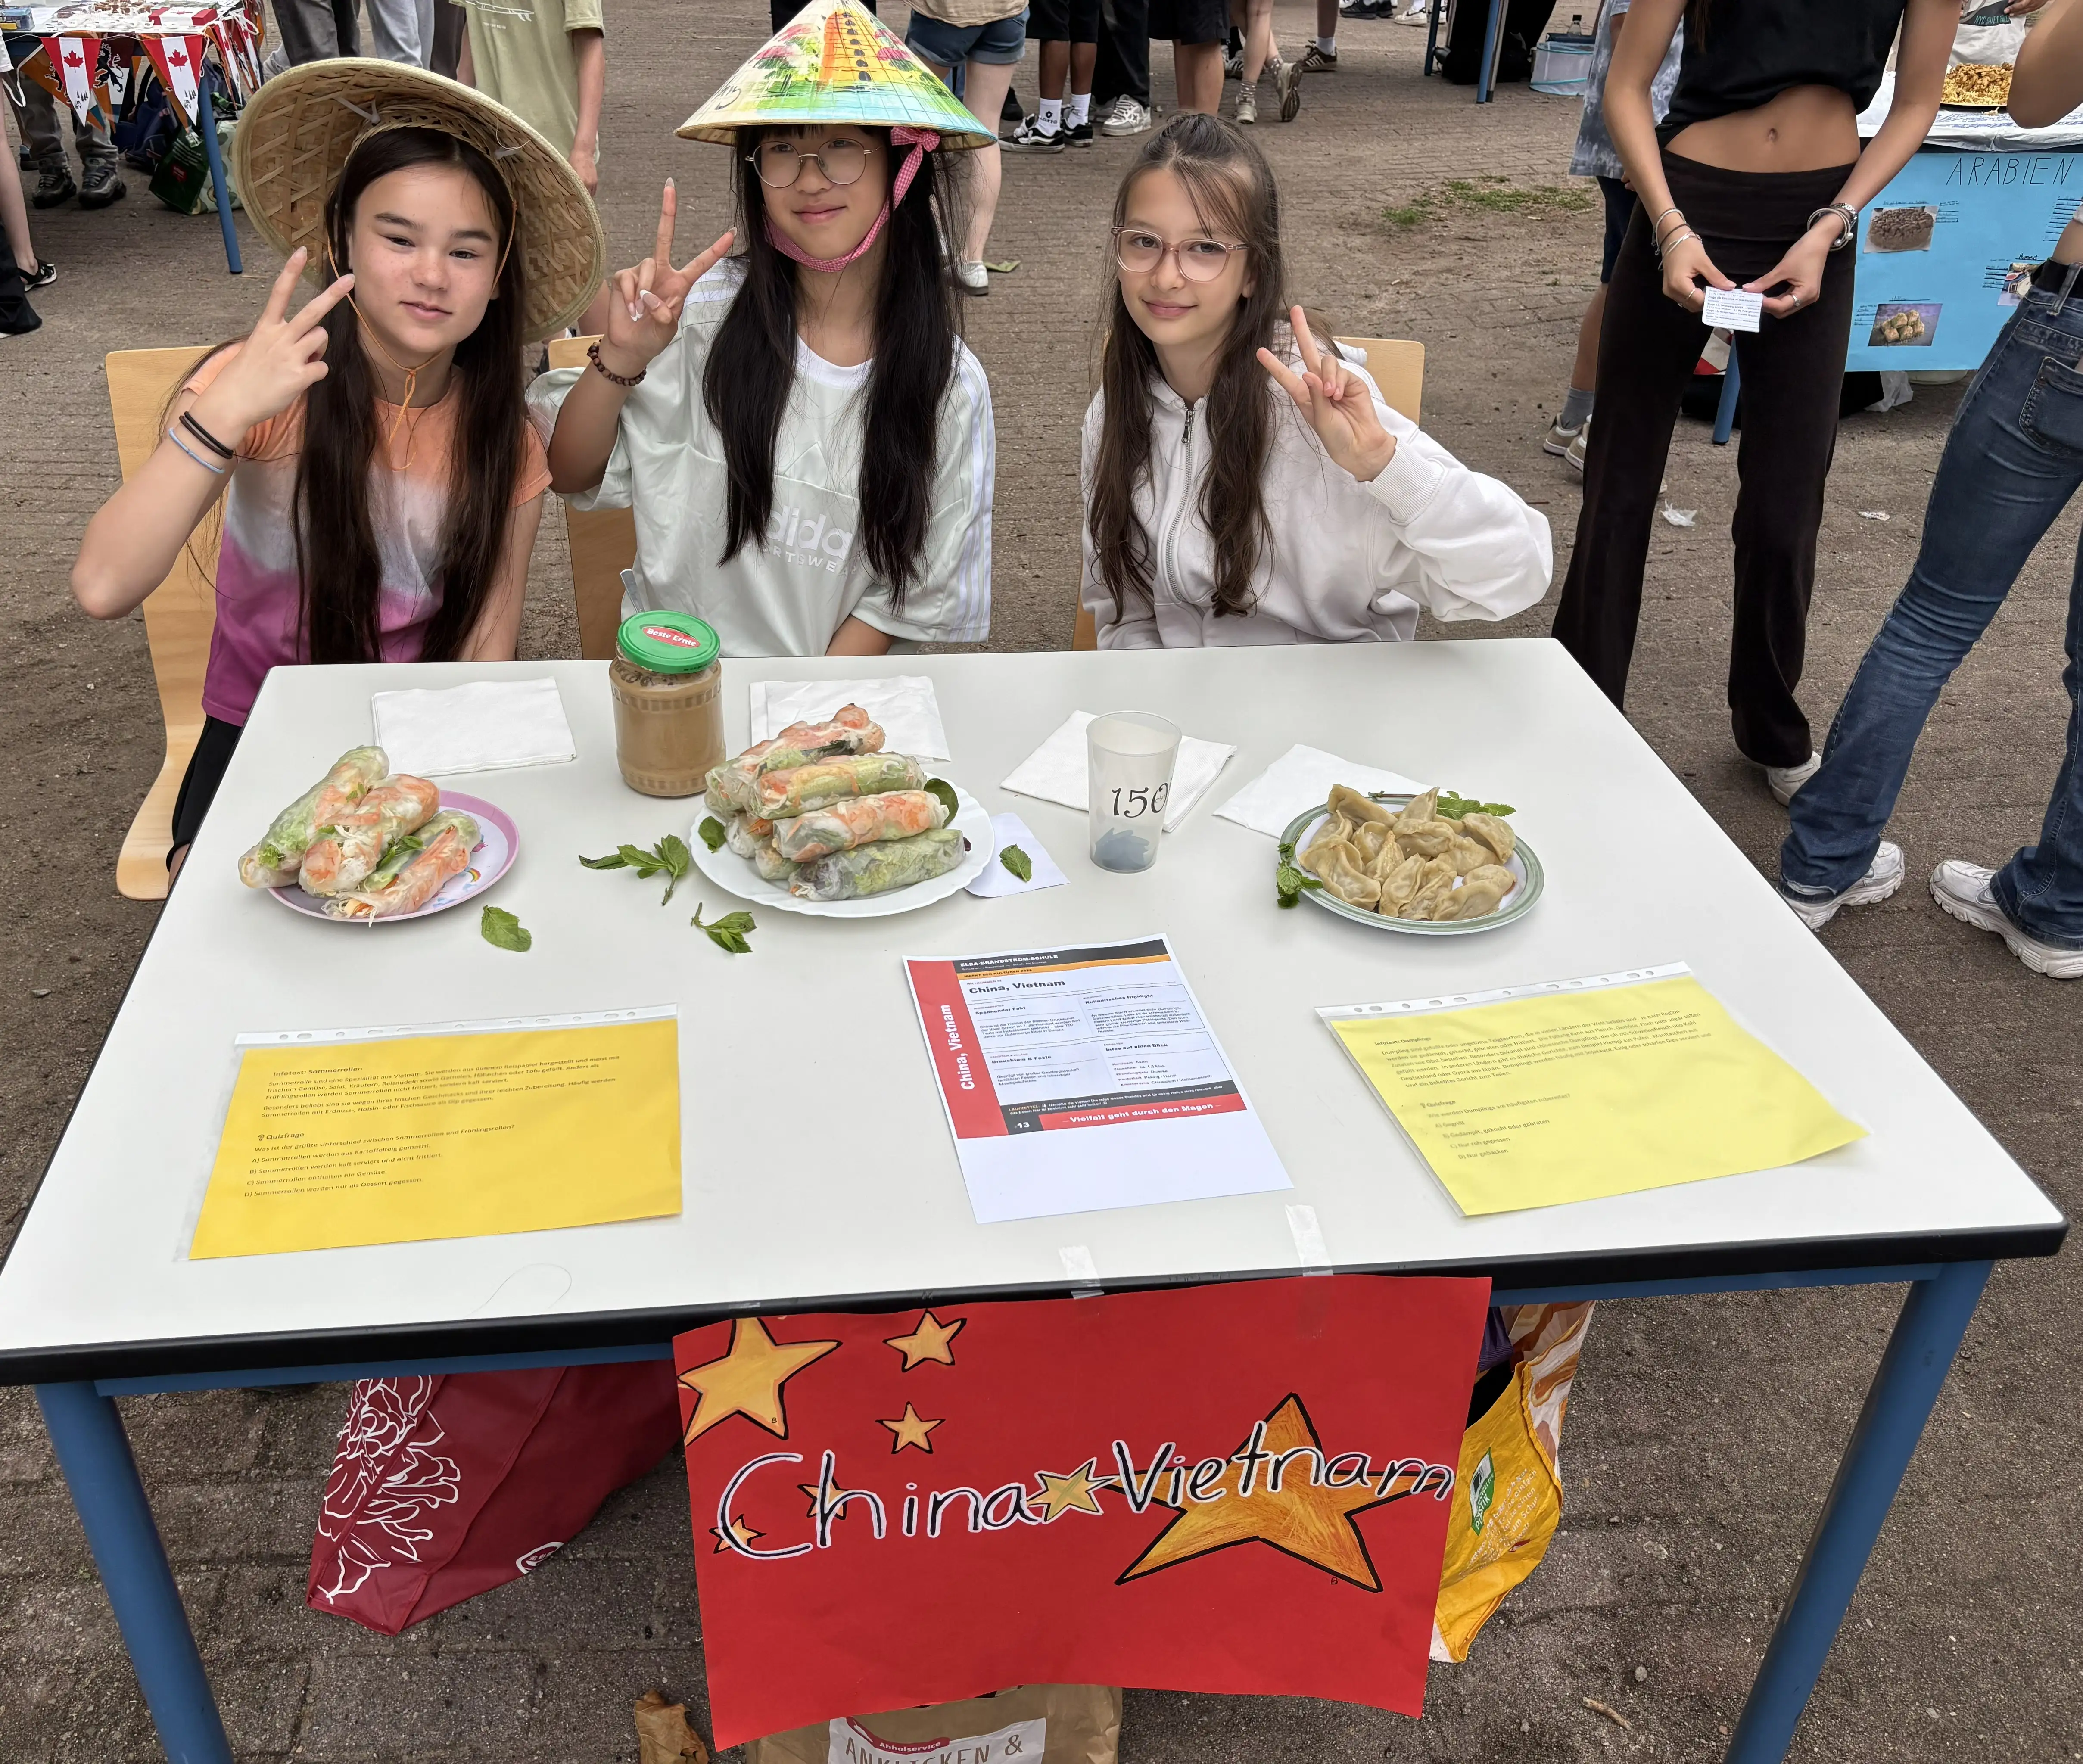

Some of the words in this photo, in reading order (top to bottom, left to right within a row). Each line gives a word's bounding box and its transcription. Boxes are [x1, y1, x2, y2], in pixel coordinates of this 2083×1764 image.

[1946, 157, 2074, 186] ARABIEN
[766, 505, 854, 560] dida
[646, 628, 671, 639] Beste
[673, 635, 697, 646] Ernte
[968, 984, 1010, 994] China,
[1012, 979, 1066, 989] Vietnam
[940, 1005, 962, 1051] Vietnam
[956, 1053, 975, 1090] China,
[1069, 1113, 1106, 1123] Vielfalt
[1106, 1111, 1130, 1120] geht
[1180, 1103, 1214, 1112] Magen
[717, 1450, 1040, 1560] China
[1112, 1420, 1455, 1514] Vietnam
[1517, 1487, 1535, 1508] einen
[1521, 1493, 1539, 1518] Schu
[879, 1741, 941, 1752] Abholservice
[1004, 1734, 1024, 1755] &
